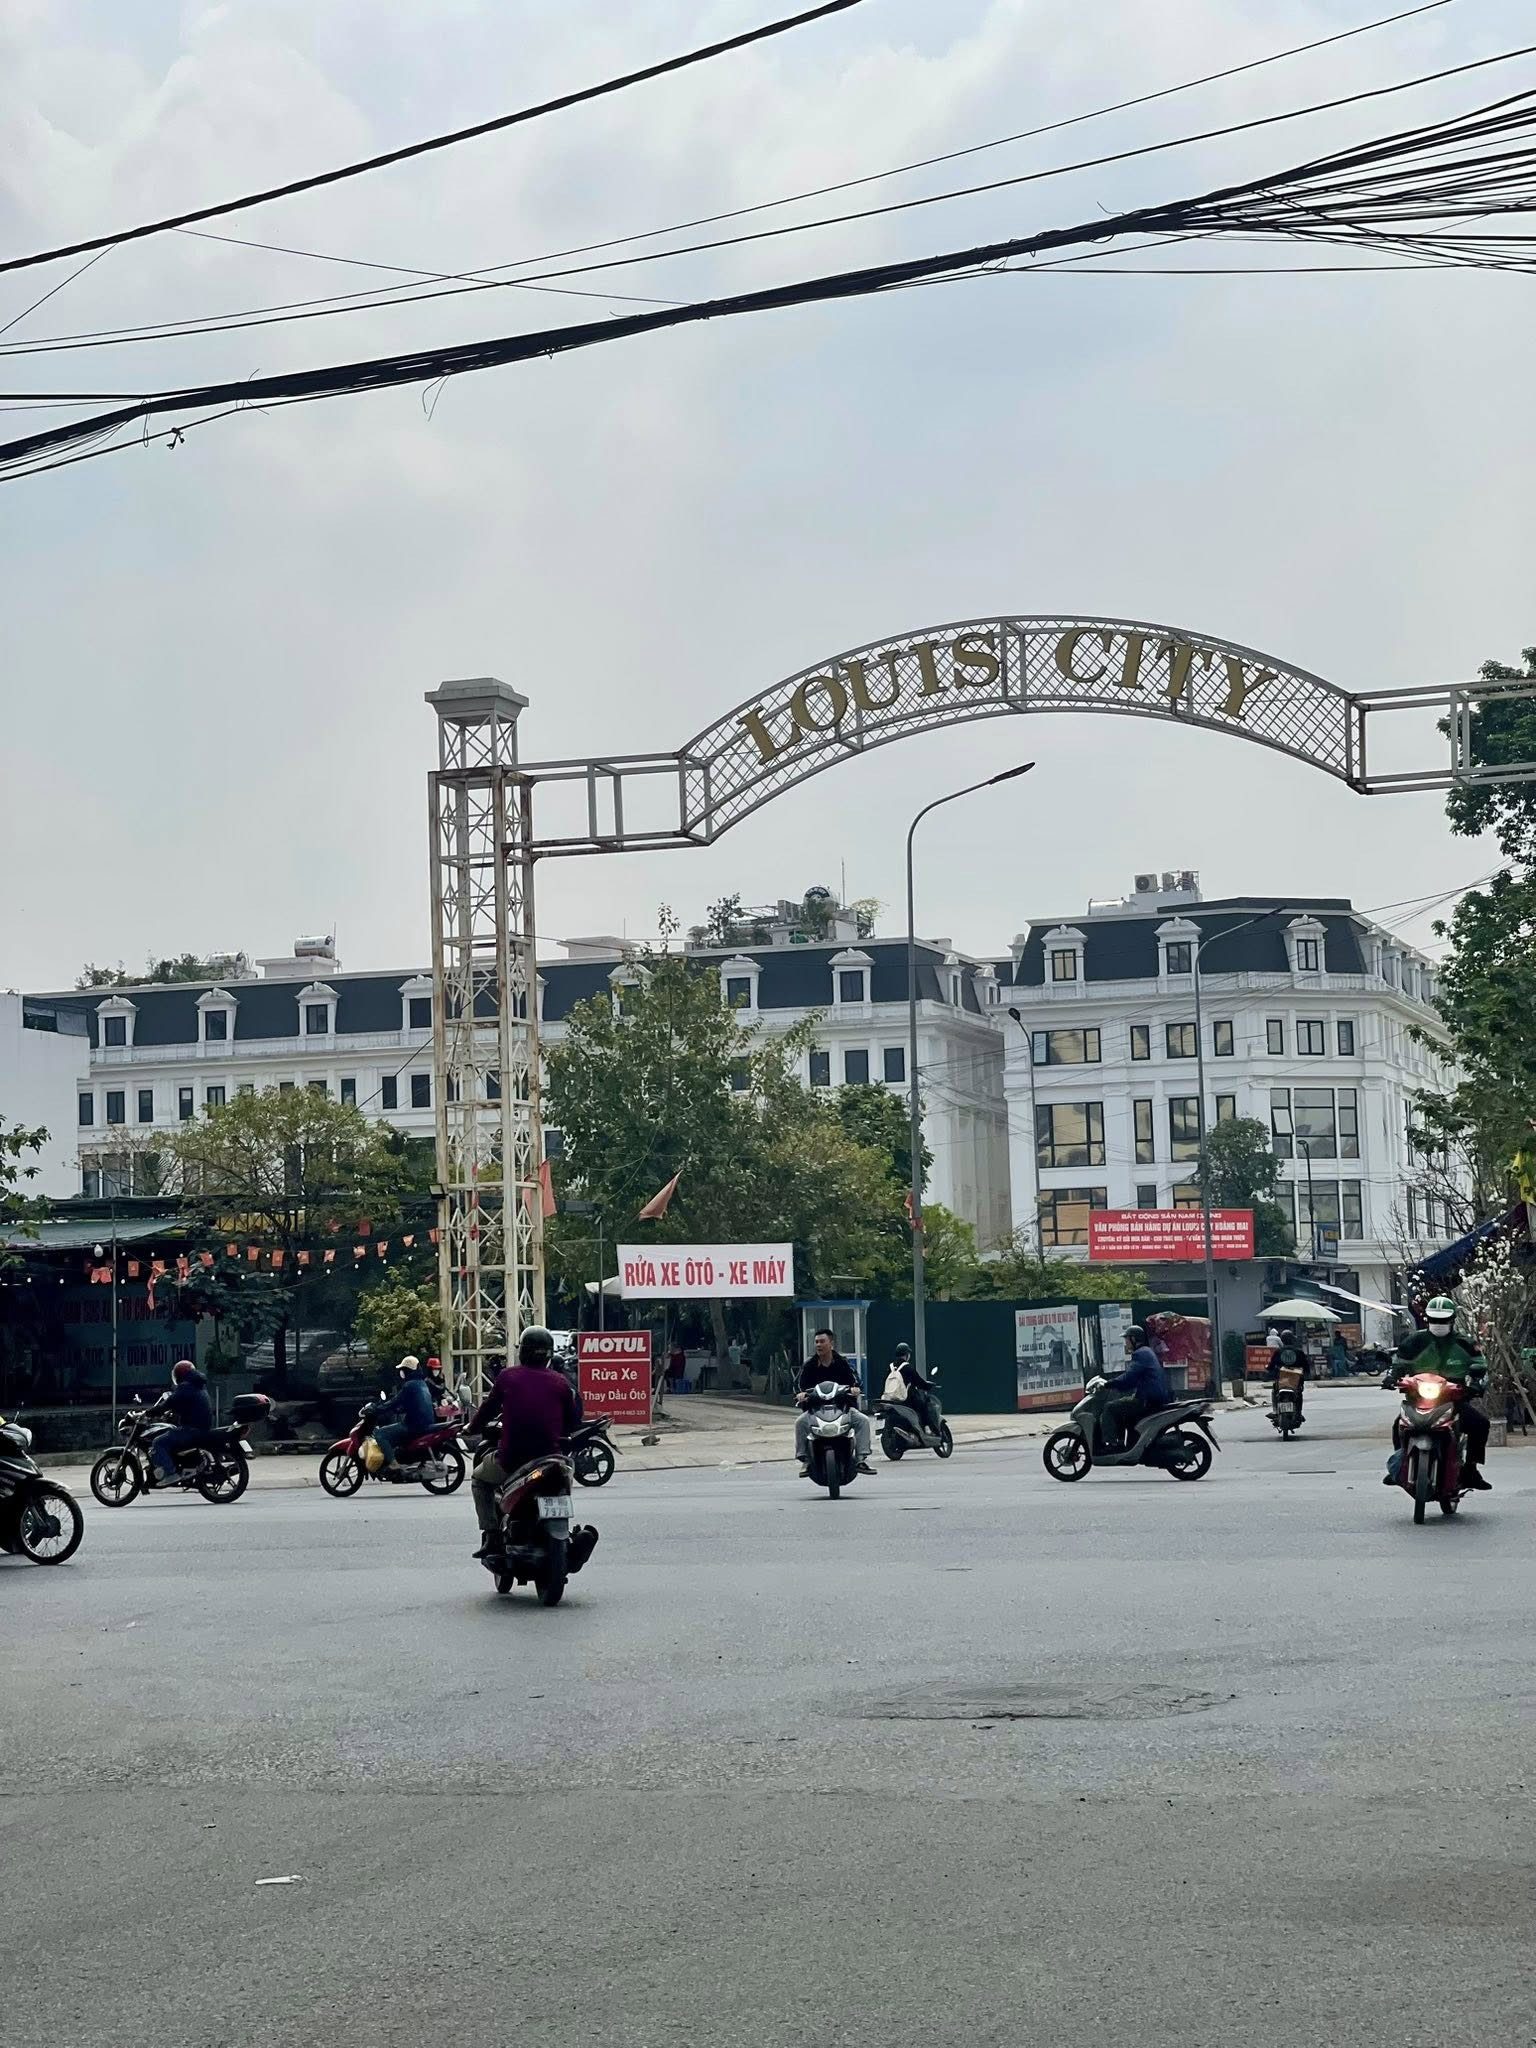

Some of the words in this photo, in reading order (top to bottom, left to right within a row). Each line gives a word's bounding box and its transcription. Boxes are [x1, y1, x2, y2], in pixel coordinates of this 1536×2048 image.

[737, 629, 1001, 765] LOUIS
[1055, 627, 1278, 721] CITY
[1130, 1221, 1143, 1232] BÁN
[625, 1254, 656, 1287] RỬA
[661, 1262, 680, 1286] XE
[685, 1257, 713, 1286] ÔTÔ
[729, 1261, 748, 1285] XE
[753, 1256, 786, 1284] MÁY
[582, 1337, 646, 1353] MOTUL
[591, 1367, 617, 1381] Rửa
[621, 1368, 638, 1380] Xe
[583, 1391, 606, 1403] Thay
[608, 1388, 627, 1400] Dầu
